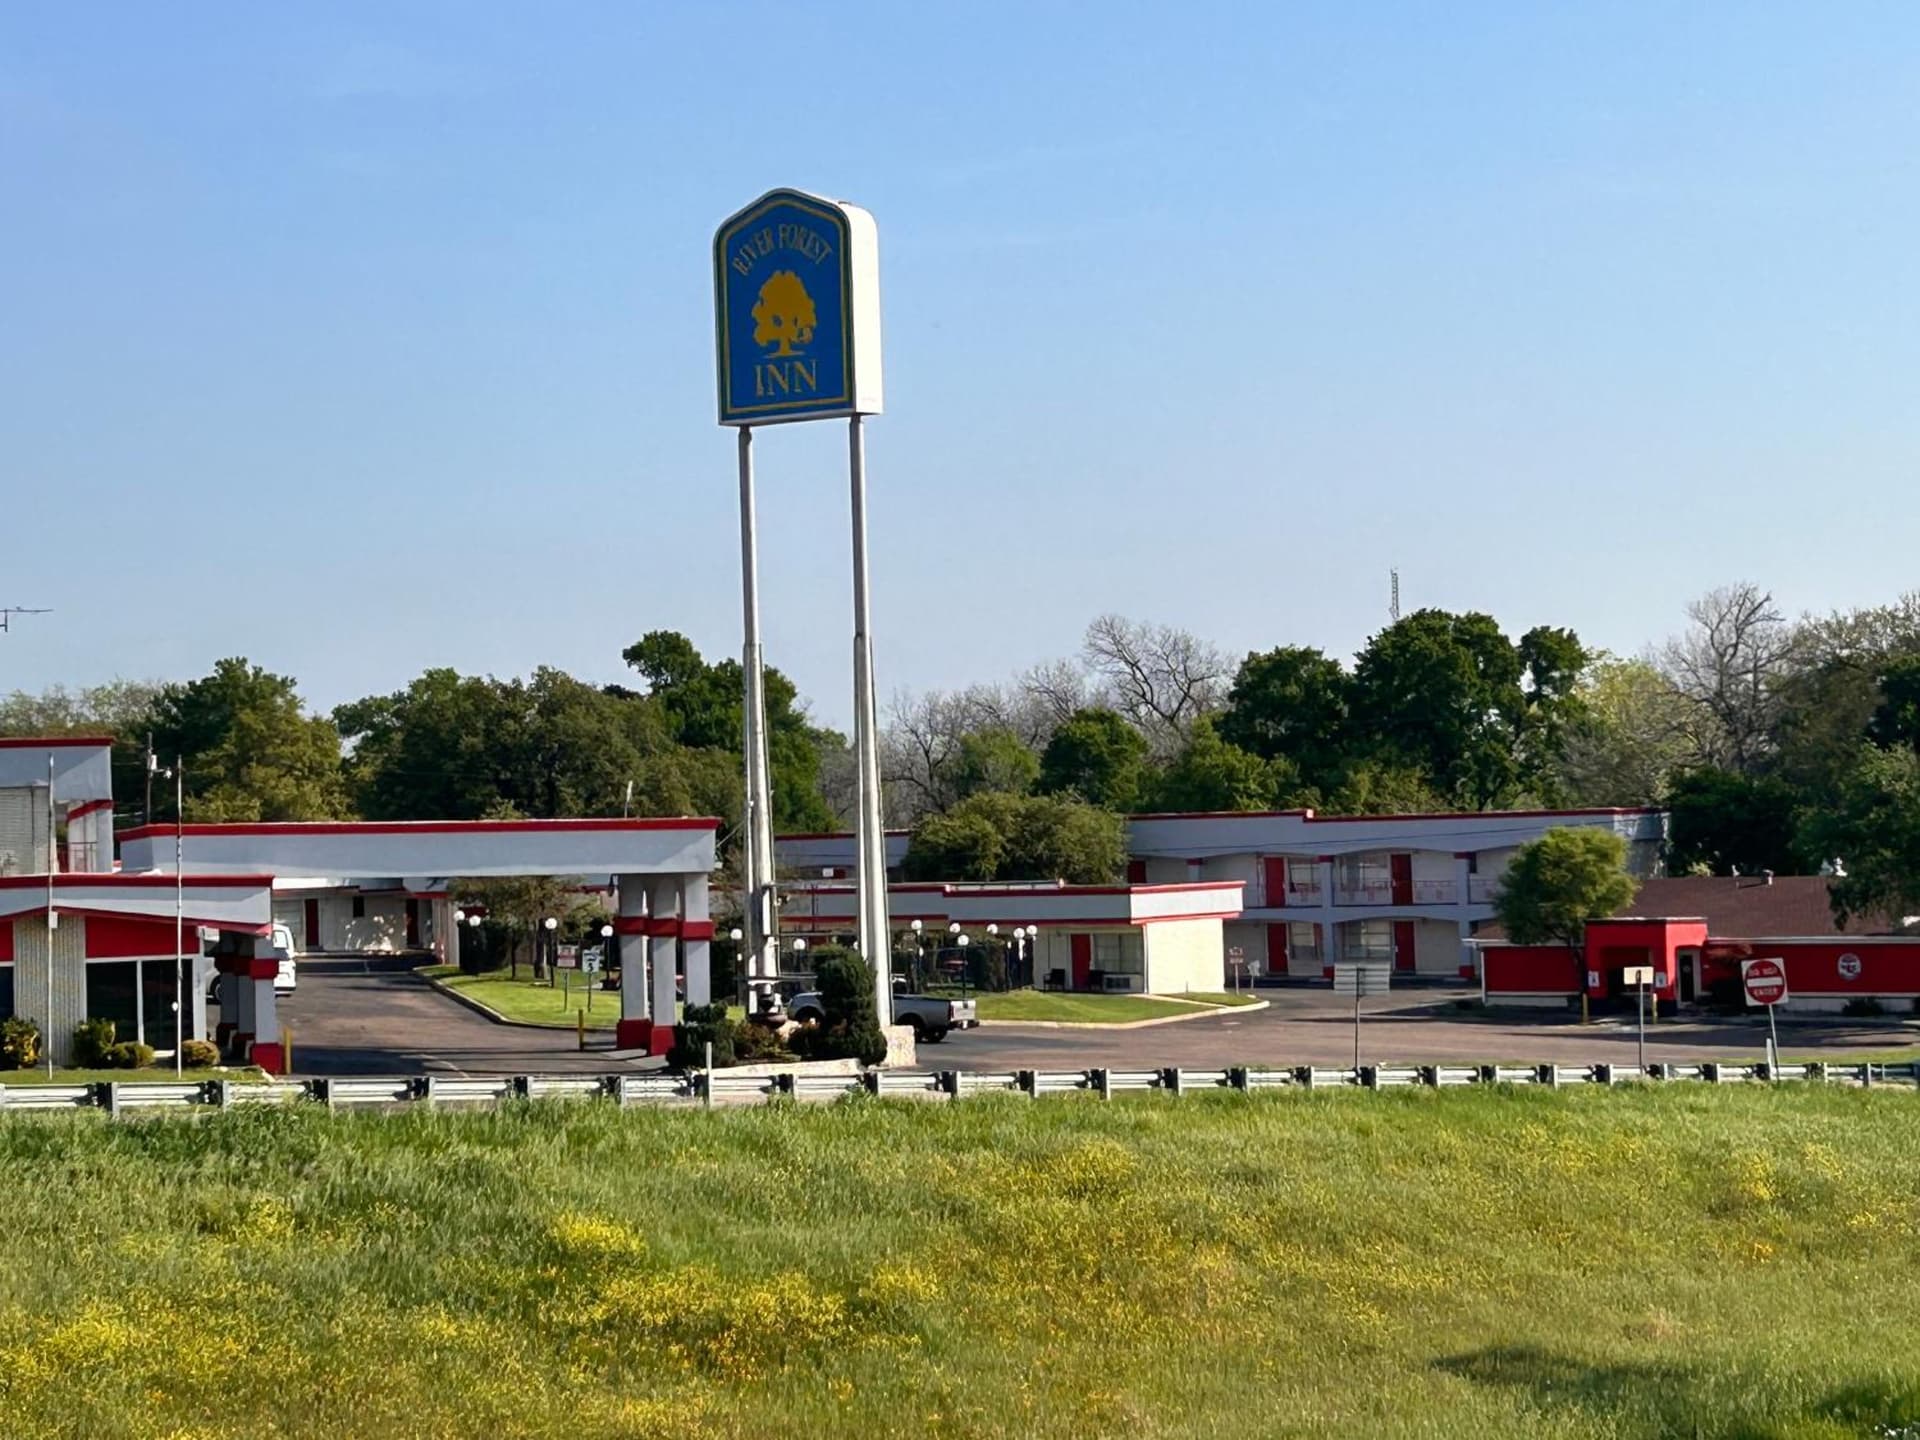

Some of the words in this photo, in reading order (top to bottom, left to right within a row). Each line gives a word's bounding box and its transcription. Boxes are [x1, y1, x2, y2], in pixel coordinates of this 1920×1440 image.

[733, 228, 774, 276] RIVER
[779, 223, 832, 264] FOREST
[755, 360, 816, 397] INN
